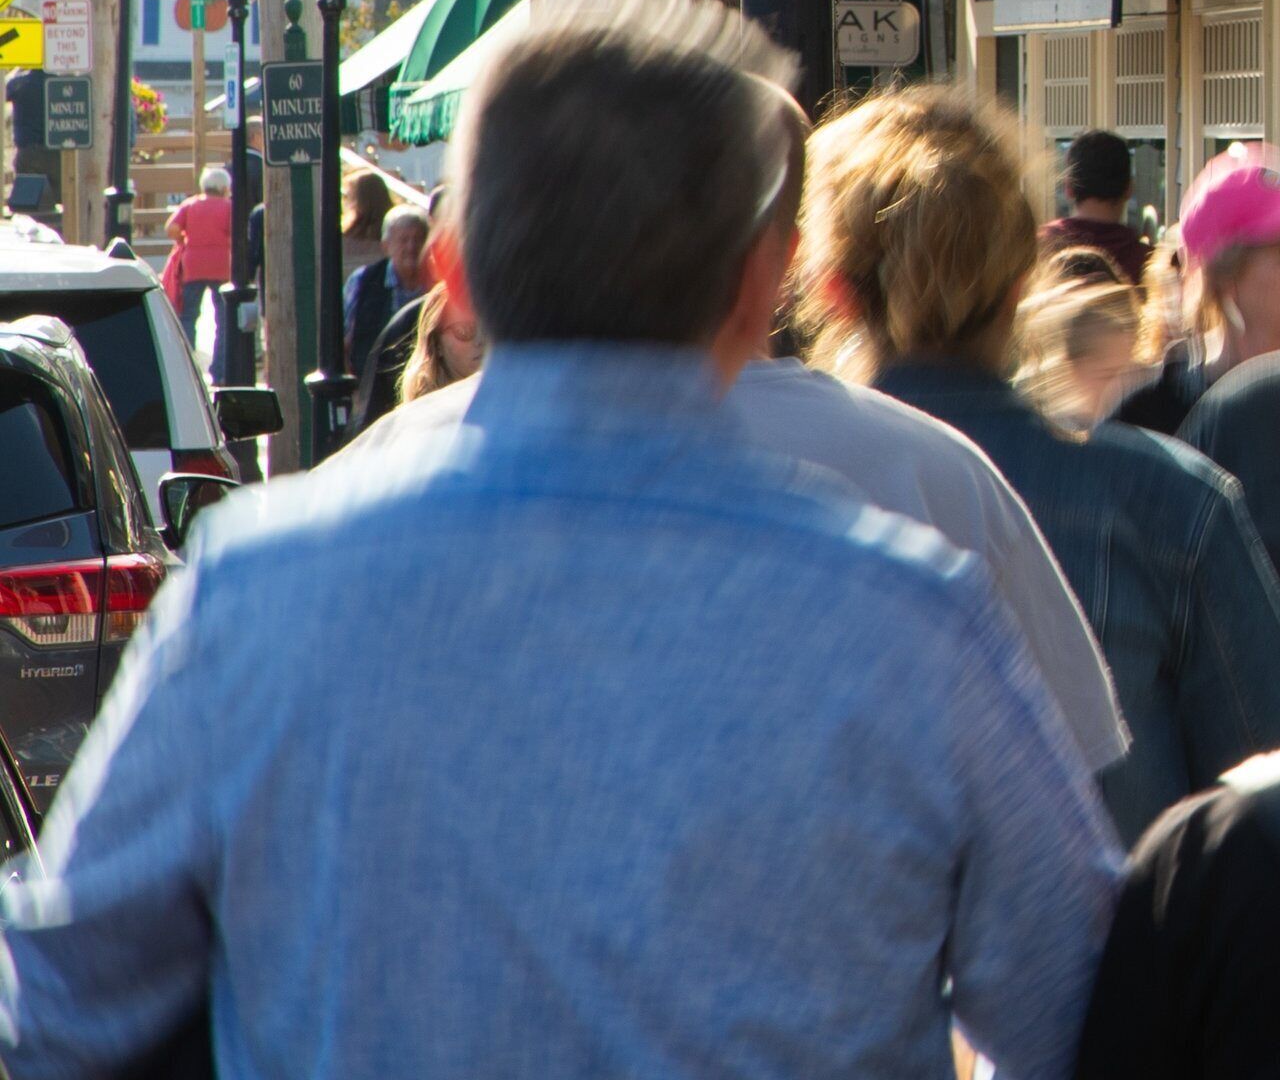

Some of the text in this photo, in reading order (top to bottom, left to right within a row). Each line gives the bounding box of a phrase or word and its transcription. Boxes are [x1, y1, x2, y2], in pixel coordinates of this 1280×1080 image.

[47, 27, 86, 39] BEYOND
[848, 33, 900, 44] IGNS
[57, 41, 77, 52] THIS
[53, 54, 80, 65] POINT
[288, 73, 303, 90] 60
[50, 101, 86, 114] MINUTE
[48, 119, 88, 131] PARKING
[21, 666, 74, 678] HYBRID
